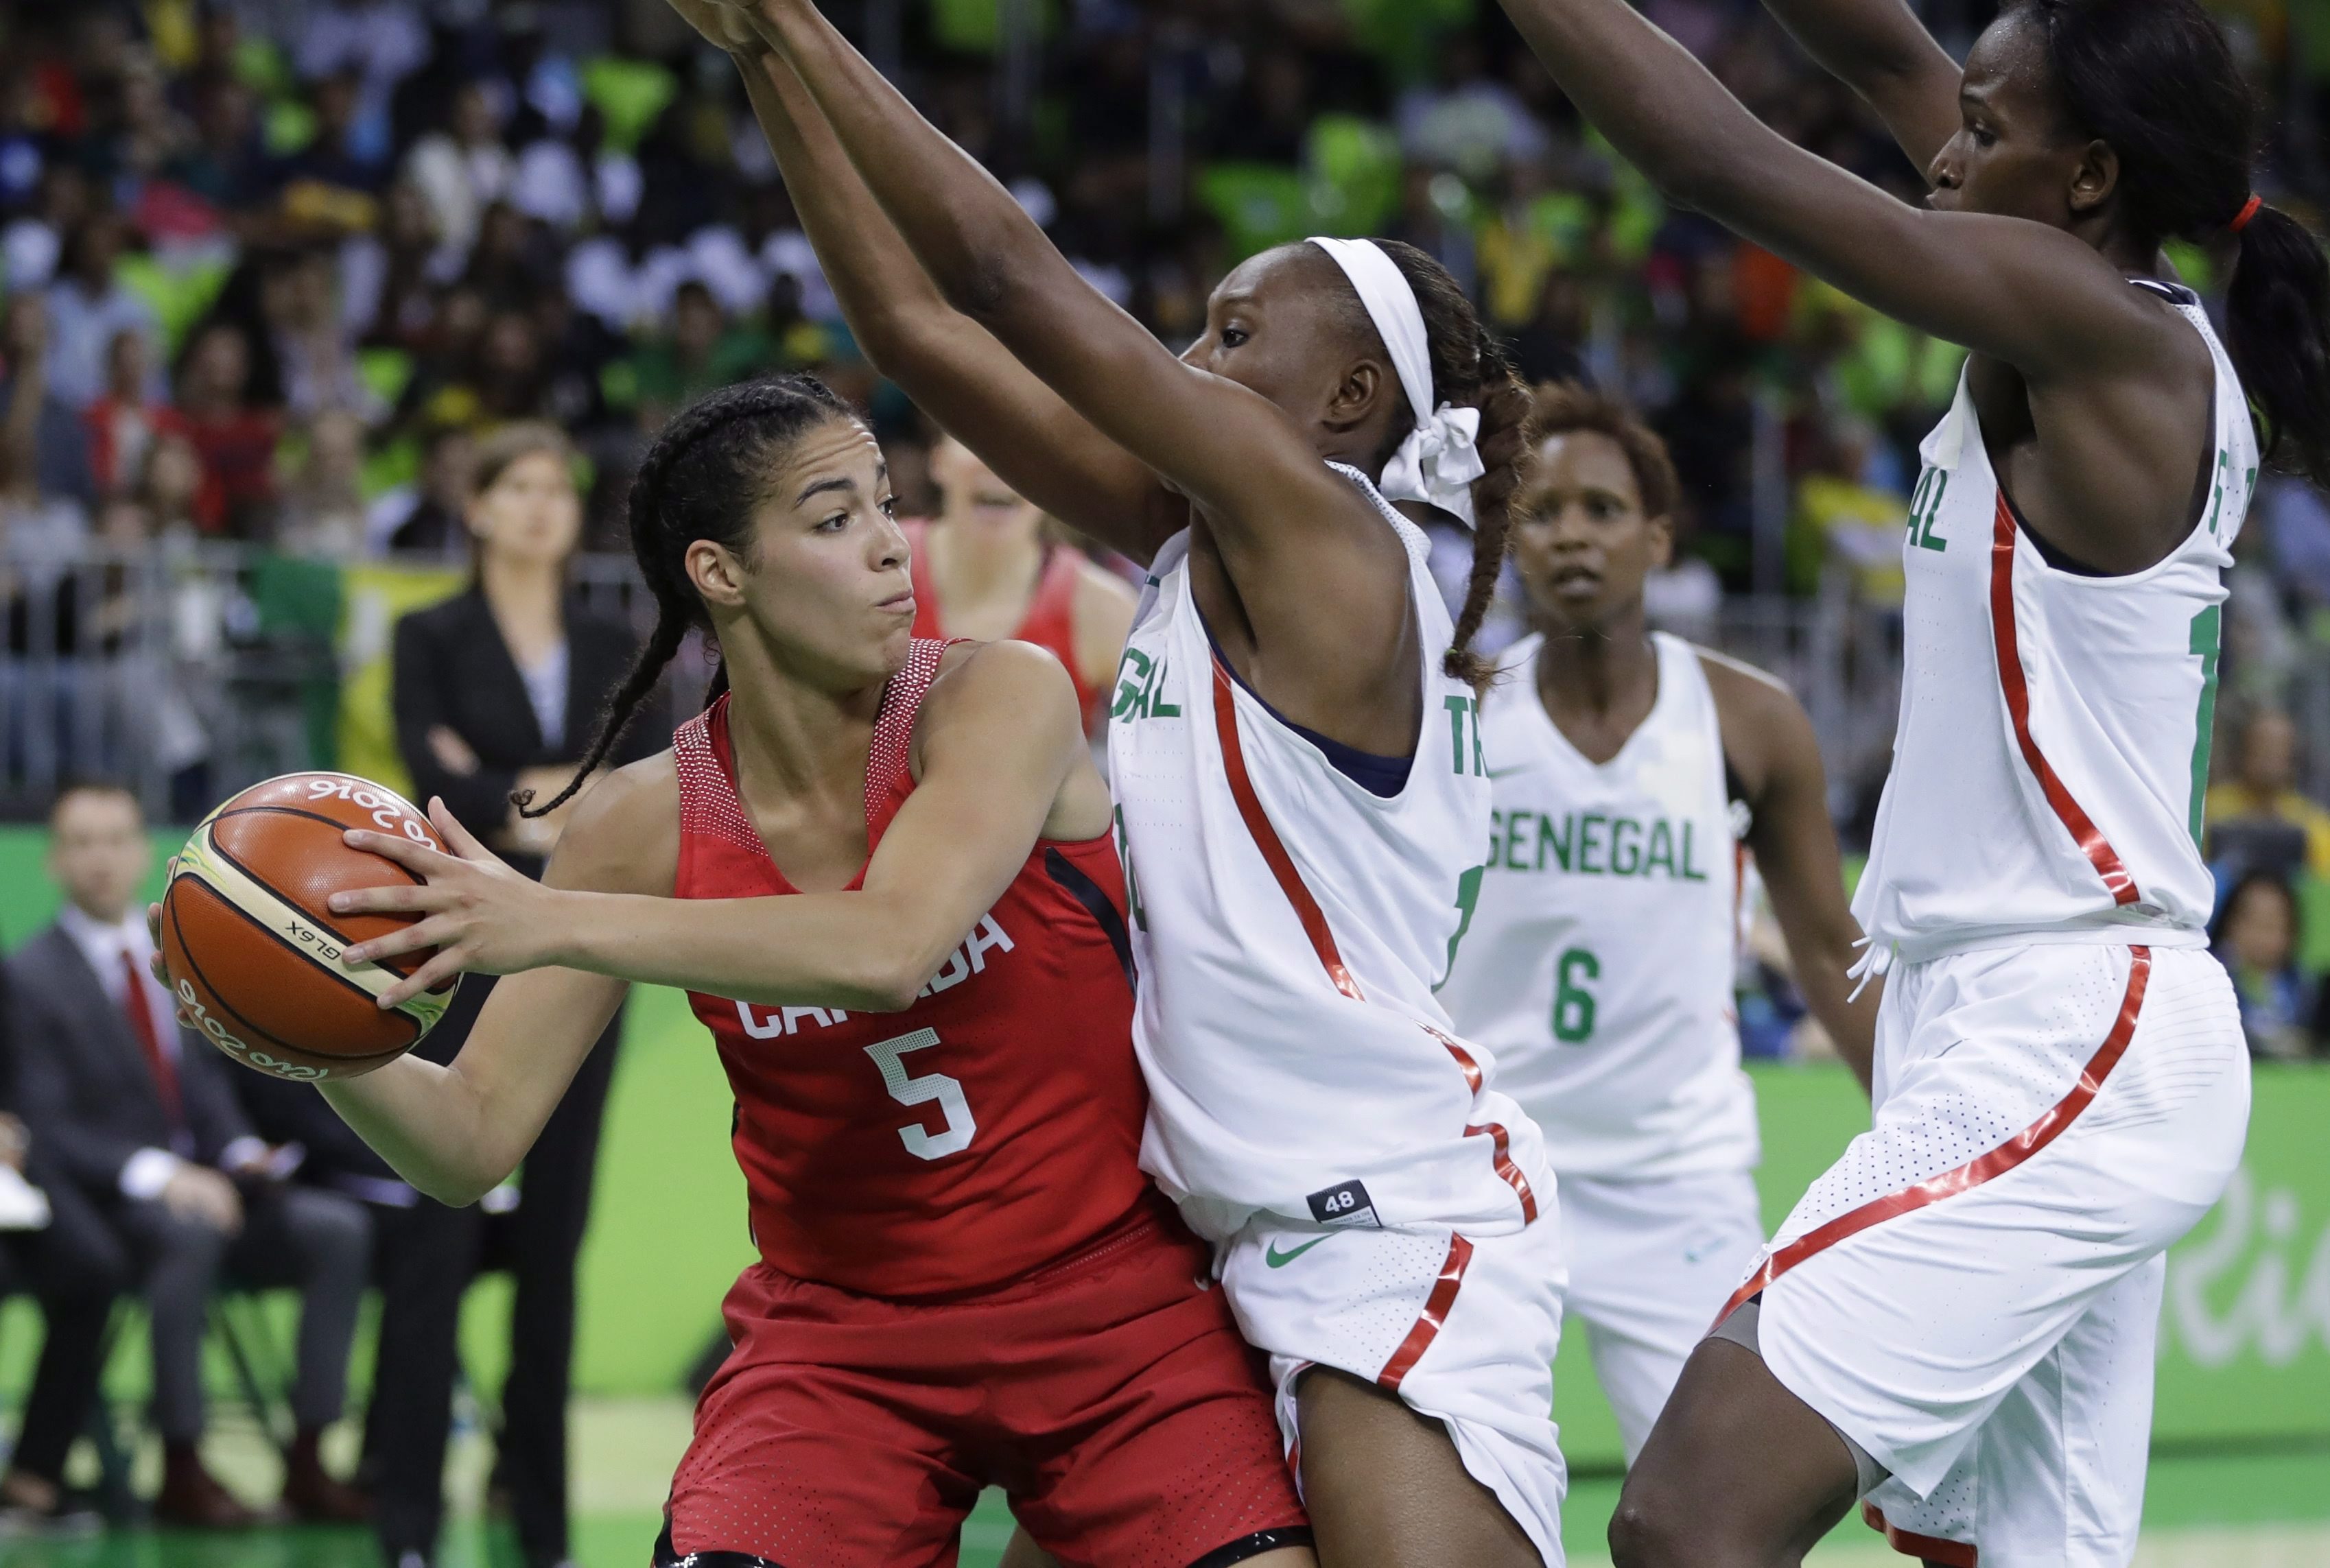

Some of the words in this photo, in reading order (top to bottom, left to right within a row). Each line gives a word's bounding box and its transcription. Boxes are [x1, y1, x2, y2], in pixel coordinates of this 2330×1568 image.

[308, 780, 401, 829] 2016
[178, 979, 248, 1056] 2016
[1552, 947, 1601, 1045] 6
[249, 1052, 329, 1080] Rio
[862, 1026, 977, 1161] 5
[1325, 1191, 1355, 1213] 48
